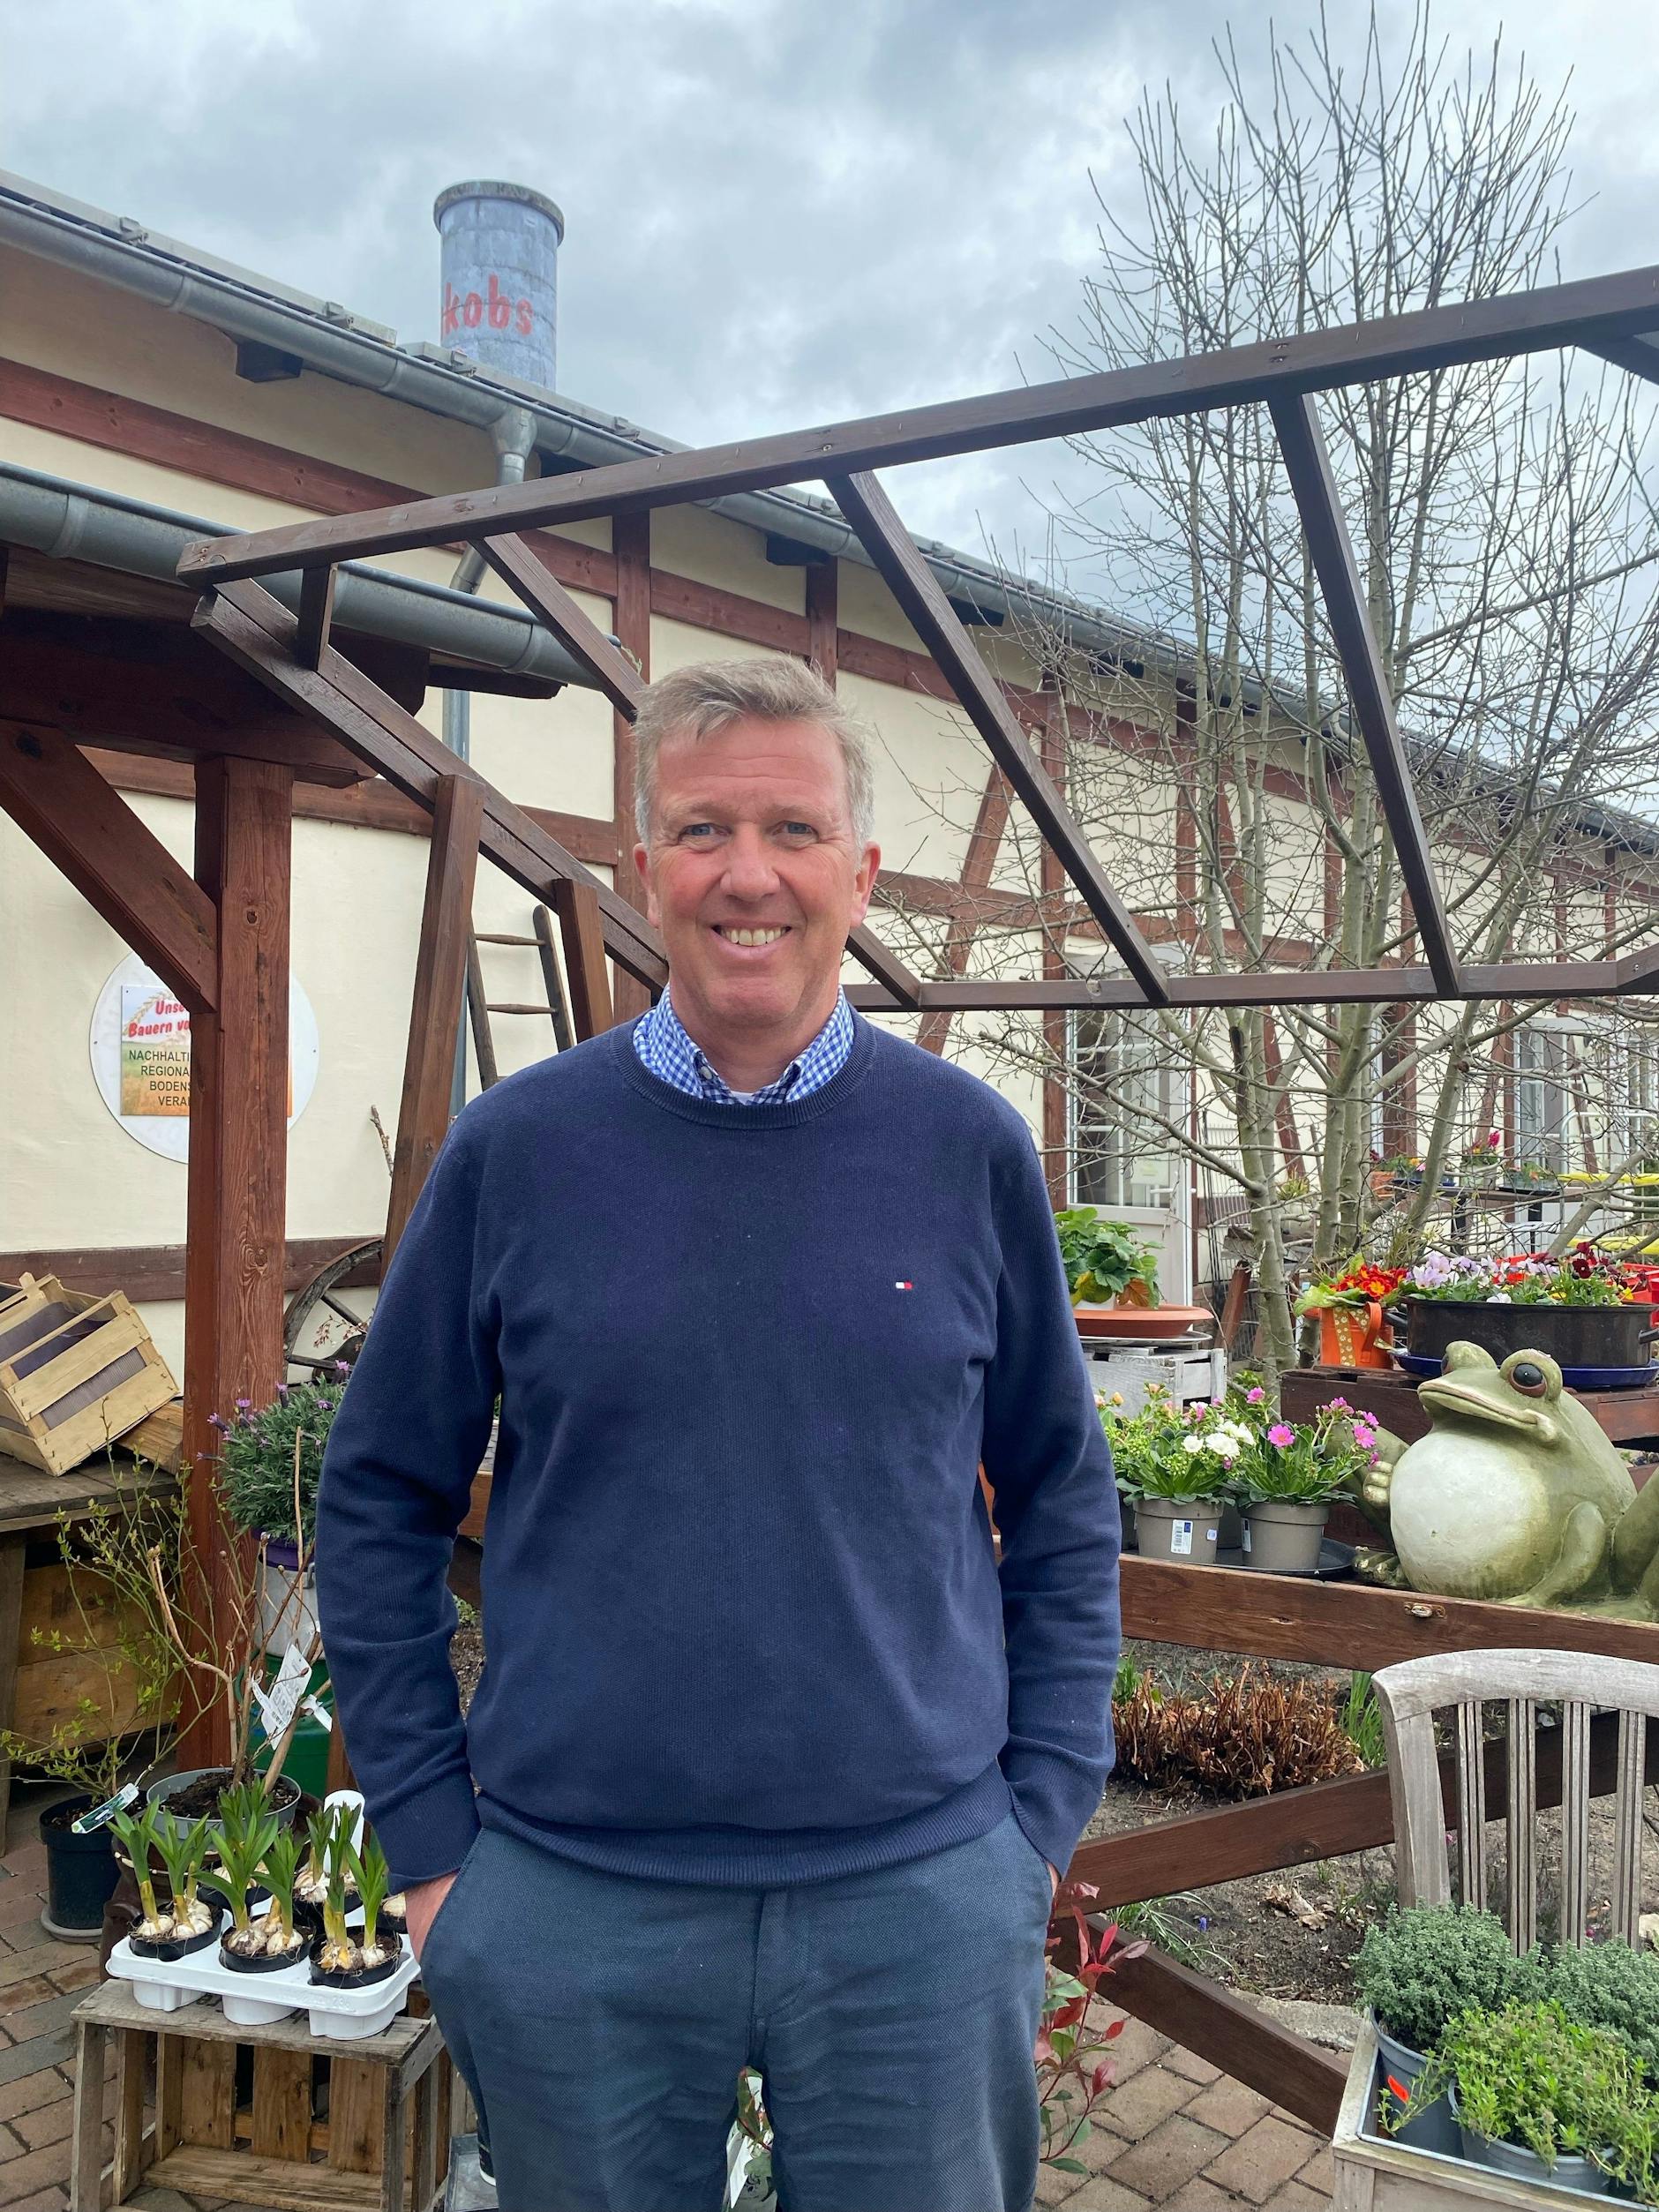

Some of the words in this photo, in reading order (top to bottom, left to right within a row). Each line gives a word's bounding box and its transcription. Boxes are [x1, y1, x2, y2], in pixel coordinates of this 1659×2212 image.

[128, 1021, 173, 1038] Bauern
[129, 1050, 190, 1062] NACHHALTI
[140, 1065, 191, 1076] REGIONA
